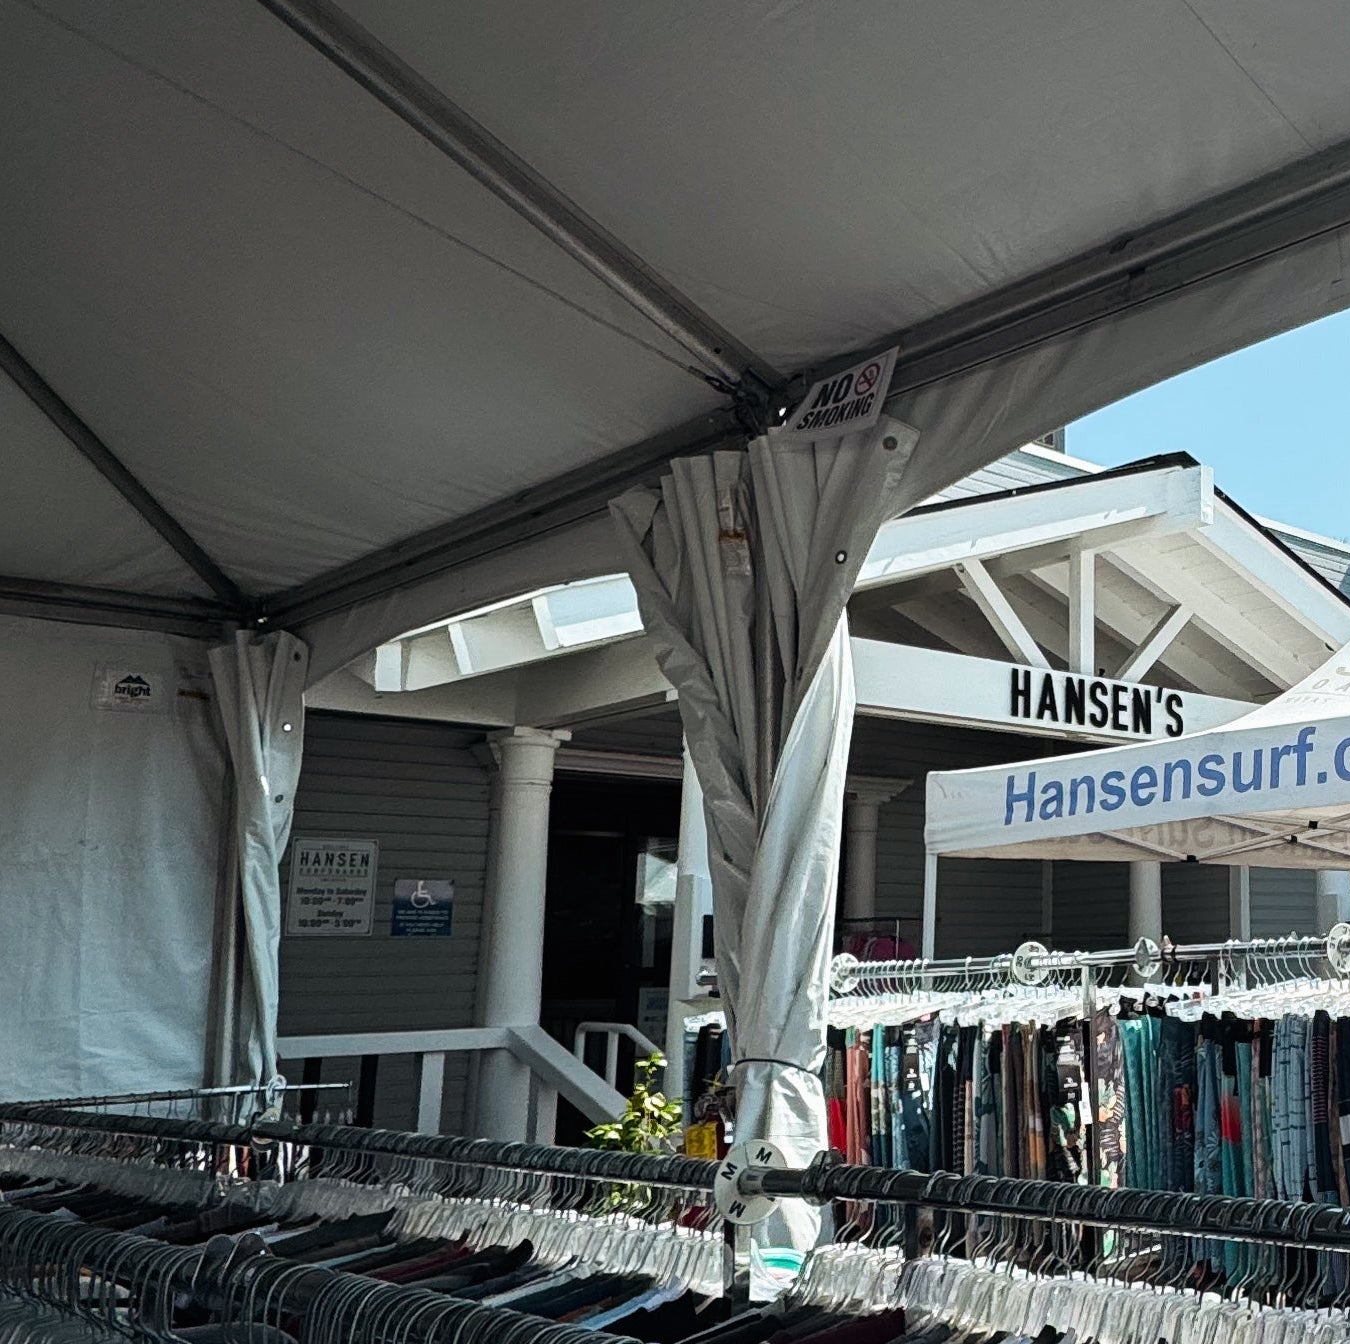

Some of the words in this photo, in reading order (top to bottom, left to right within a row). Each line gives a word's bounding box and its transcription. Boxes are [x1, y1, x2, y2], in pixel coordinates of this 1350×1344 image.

[811, 374, 854, 409] NO
[797, 393, 874, 430] SMOKING
[114, 684, 151, 698] bright
[1009, 667, 1185, 737] HANSEN'S
[300, 852, 369, 867] HANSEN
[756, 1147, 772, 1164] M
[720, 1162, 738, 1181] M
[728, 1200, 746, 1218] M
